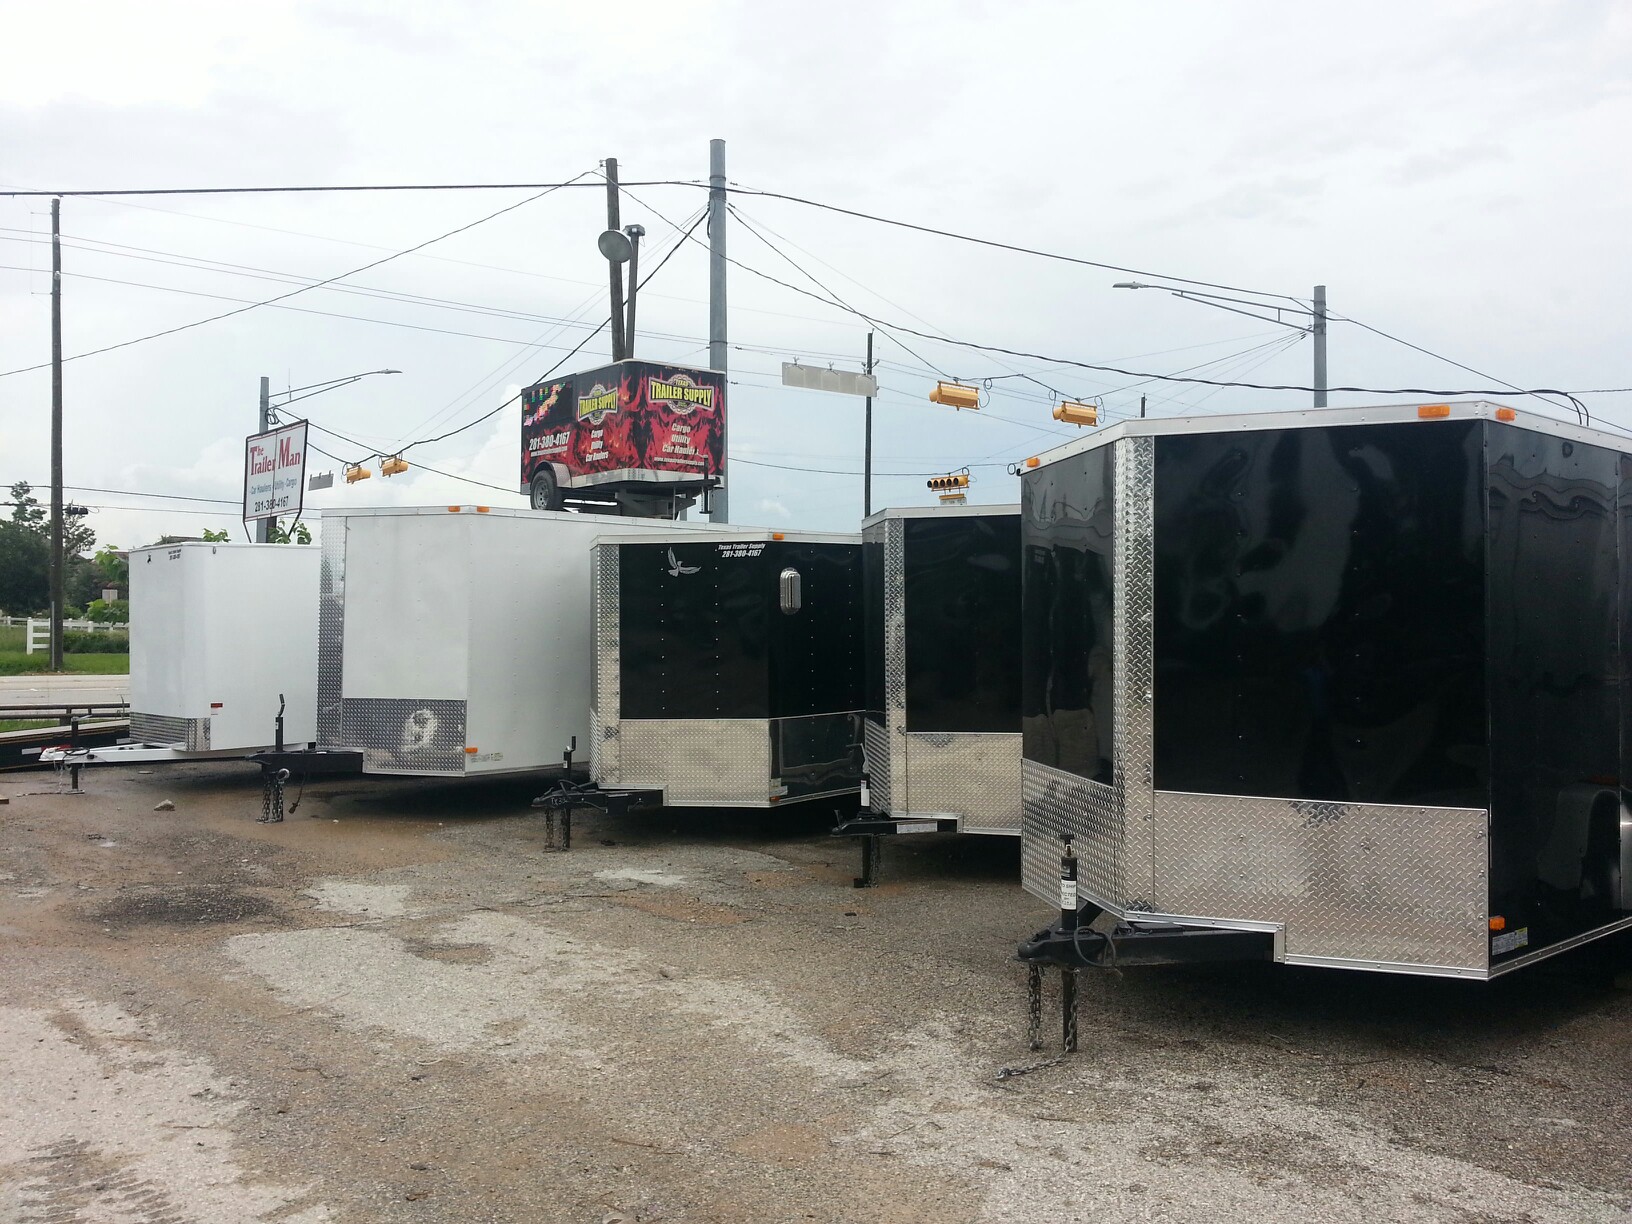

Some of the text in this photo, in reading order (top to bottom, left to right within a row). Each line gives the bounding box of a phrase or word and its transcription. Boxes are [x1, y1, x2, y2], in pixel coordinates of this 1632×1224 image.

[651, 381, 712, 407] TRAILER SUPPLY
[580, 397, 598, 417] TRAILER
[672, 423, 691, 433] Cargo
[529, 431, 570, 451] 281-380-4167
[671, 434, 691, 445] Utility
[662, 444, 674, 453] Car
[250, 436, 301, 476] Trailer Man
[254, 495, 289, 513] 281-380-4167
[749, 542, 766, 550] Supply
[721, 549, 762, 558] 281-380-4167
